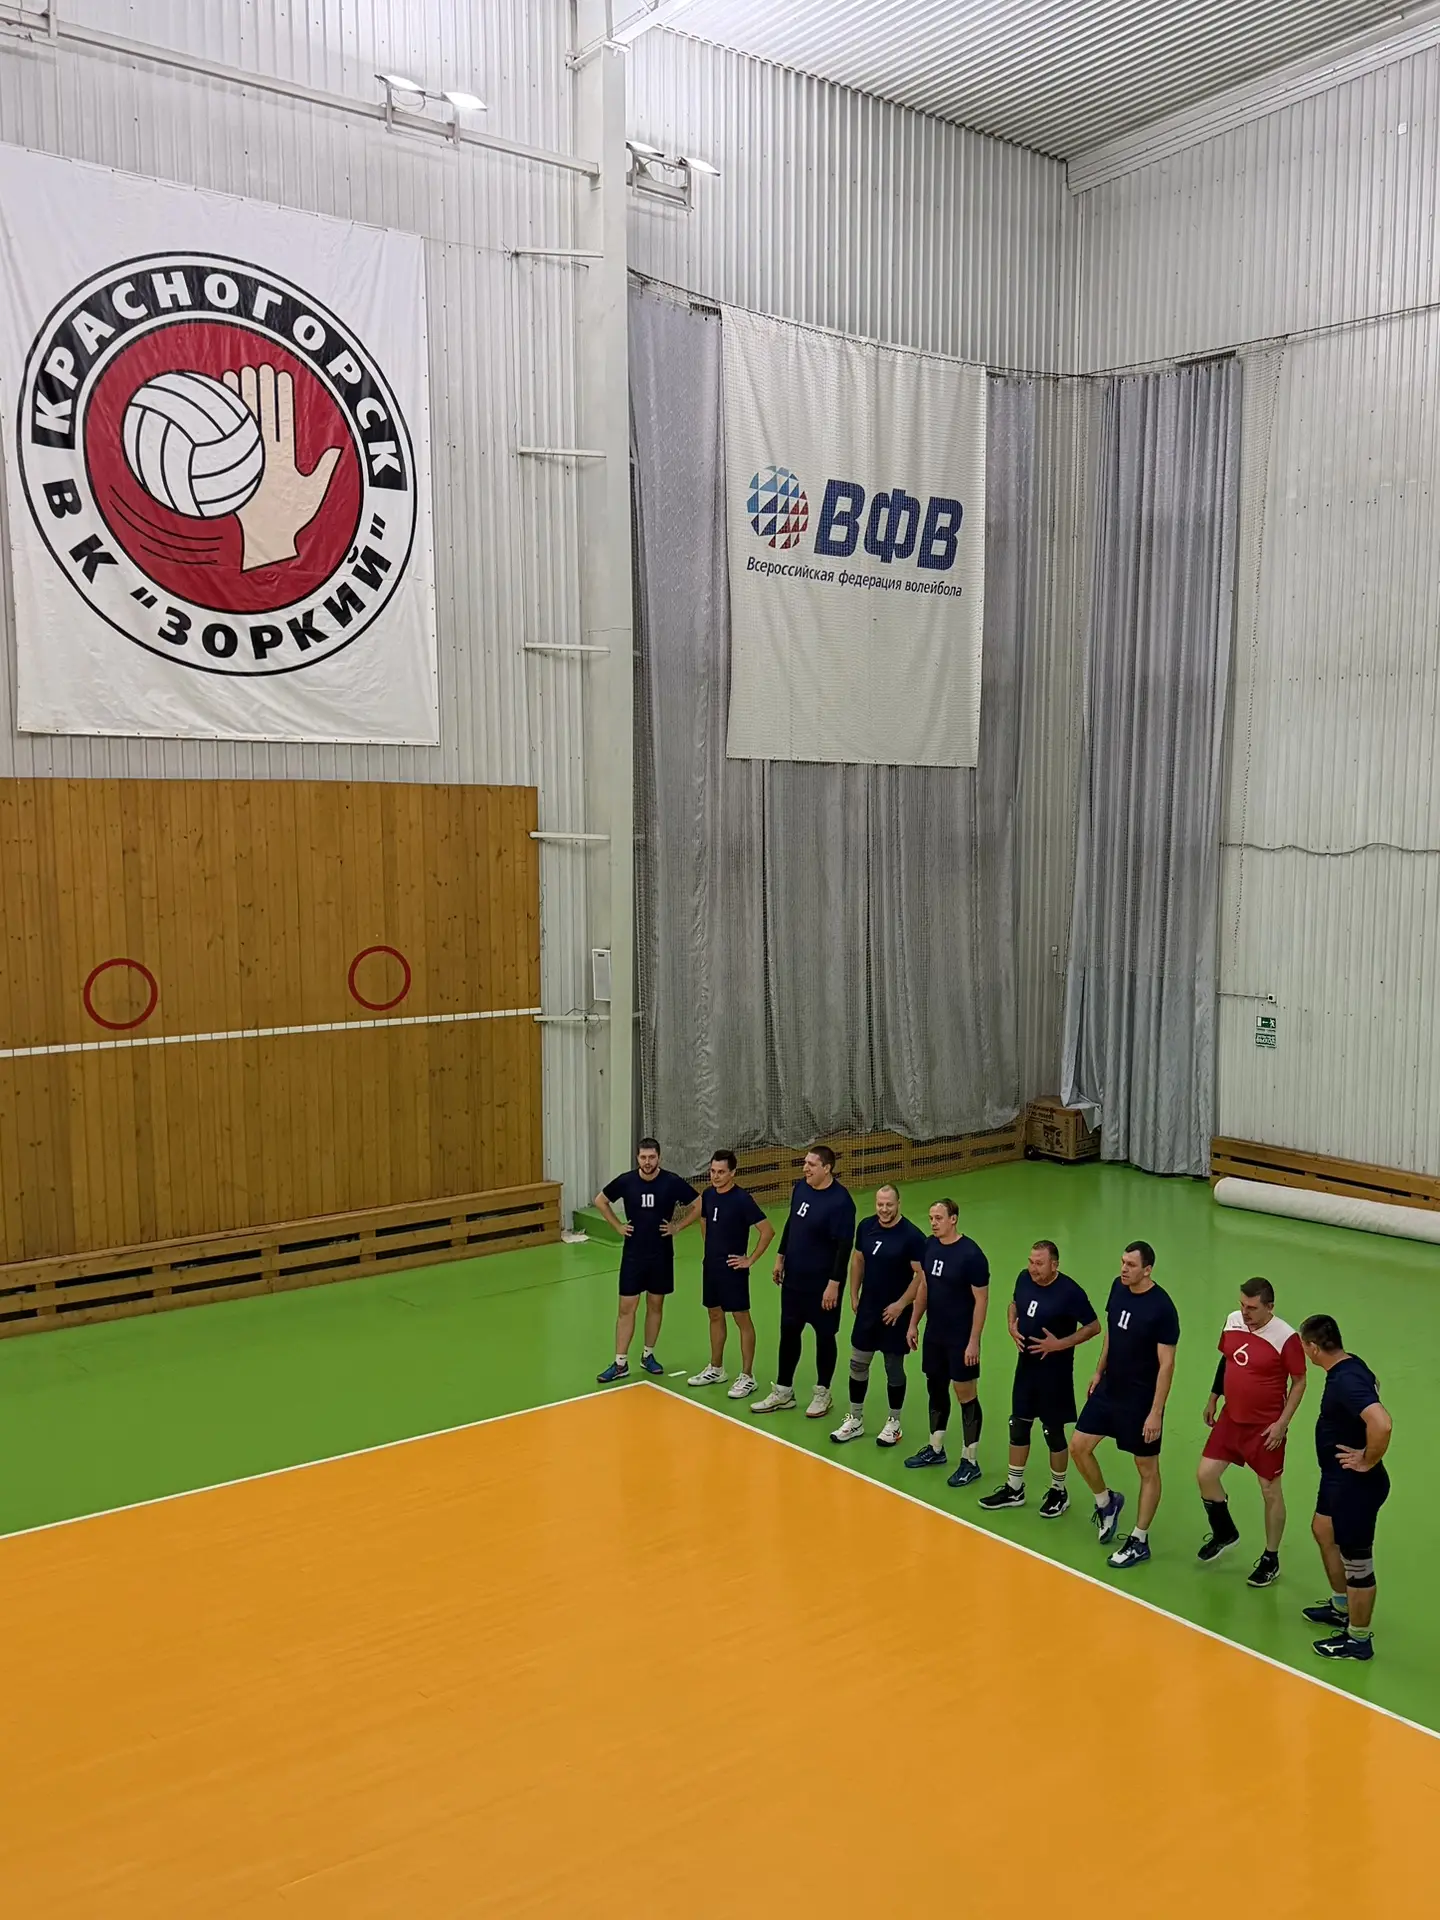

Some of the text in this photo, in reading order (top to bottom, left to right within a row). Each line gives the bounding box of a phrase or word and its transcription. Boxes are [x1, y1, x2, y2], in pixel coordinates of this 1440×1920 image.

[35, 270, 402, 479] КРАСНОГОРСК
[813, 478, 964, 571] ВФВ
[746, 556, 963, 597] Всероссийская федерация волейбола
[641, 1193, 654, 1207] 10
[712, 1207, 718, 1222] 1
[796, 1201, 809, 1218] 15
[872, 1240, 882, 1255] 7
[931, 1259, 944, 1276] 13
[1026, 1300, 1038, 1317] 8
[1117, 1310, 1131, 1329] 11
[1233, 1343, 1249, 1366] 6
